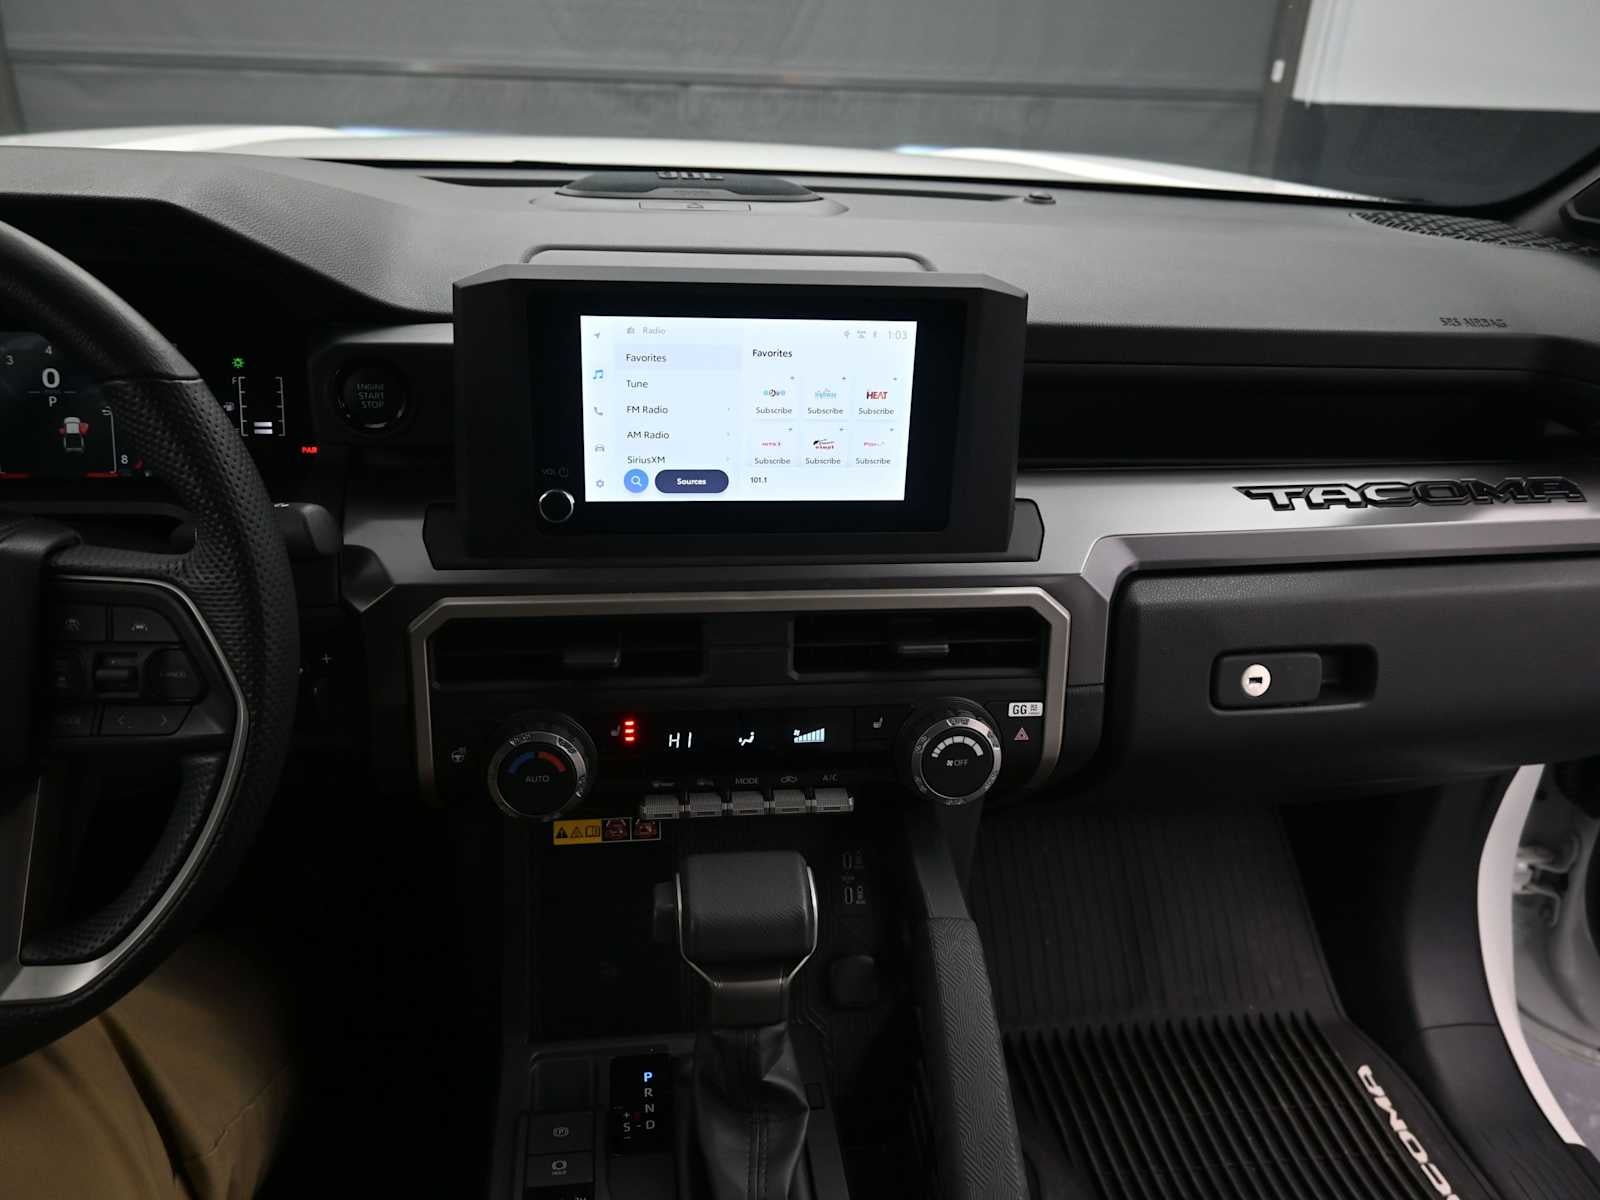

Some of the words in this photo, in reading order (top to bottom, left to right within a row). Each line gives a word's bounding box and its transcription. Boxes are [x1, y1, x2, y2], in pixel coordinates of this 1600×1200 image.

[642, 326, 666, 336] Radio
[888, 330, 908, 340] 1:03
[45, 345, 53, 355] 4
[752, 348, 793, 358] Favorites
[6, 354, 15, 365] 3
[626, 353, 667, 363] Favorites
[41, 367, 61, 389] 0
[626, 379, 649, 389] Tune
[358, 391, 385, 400] START
[866, 391, 889, 400] HEAT
[48, 395, 58, 407] P
[360, 400, 385, 409] STOP
[626, 405, 640, 414] FM
[642, 405, 669, 414] Radio
[755, 406, 793, 415] Subscribe
[807, 406, 844, 415] Subscribe
[858, 407, 895, 416] Subscribe
[626, 431, 642, 440] AM
[644, 431, 670, 440] Radio
[120, 454, 129, 464] 8
[627, 456, 666, 465] SiriusXM
[754, 457, 791, 466] Subscribe
[805, 457, 842, 466] Subscribe
[855, 457, 892, 466] Subscribe
[676, 477, 707, 486] Sources
[750, 476, 768, 485] 101.1
[1234, 476, 1588, 511] TACOMA
[1012, 704, 1028, 715] GG
[954, 759, 969, 767] OFF
[525, 775, 551, 784] AUTO
[735, 776, 759, 785] MODE
[821, 772, 838, 783] A/C
[643, 1071, 653, 1083] P
[643, 1087, 653, 1097] R
[644, 1104, 655, 1113] N
[623, 1122, 631, 1132] S
[645, 1120, 656, 1130] D
